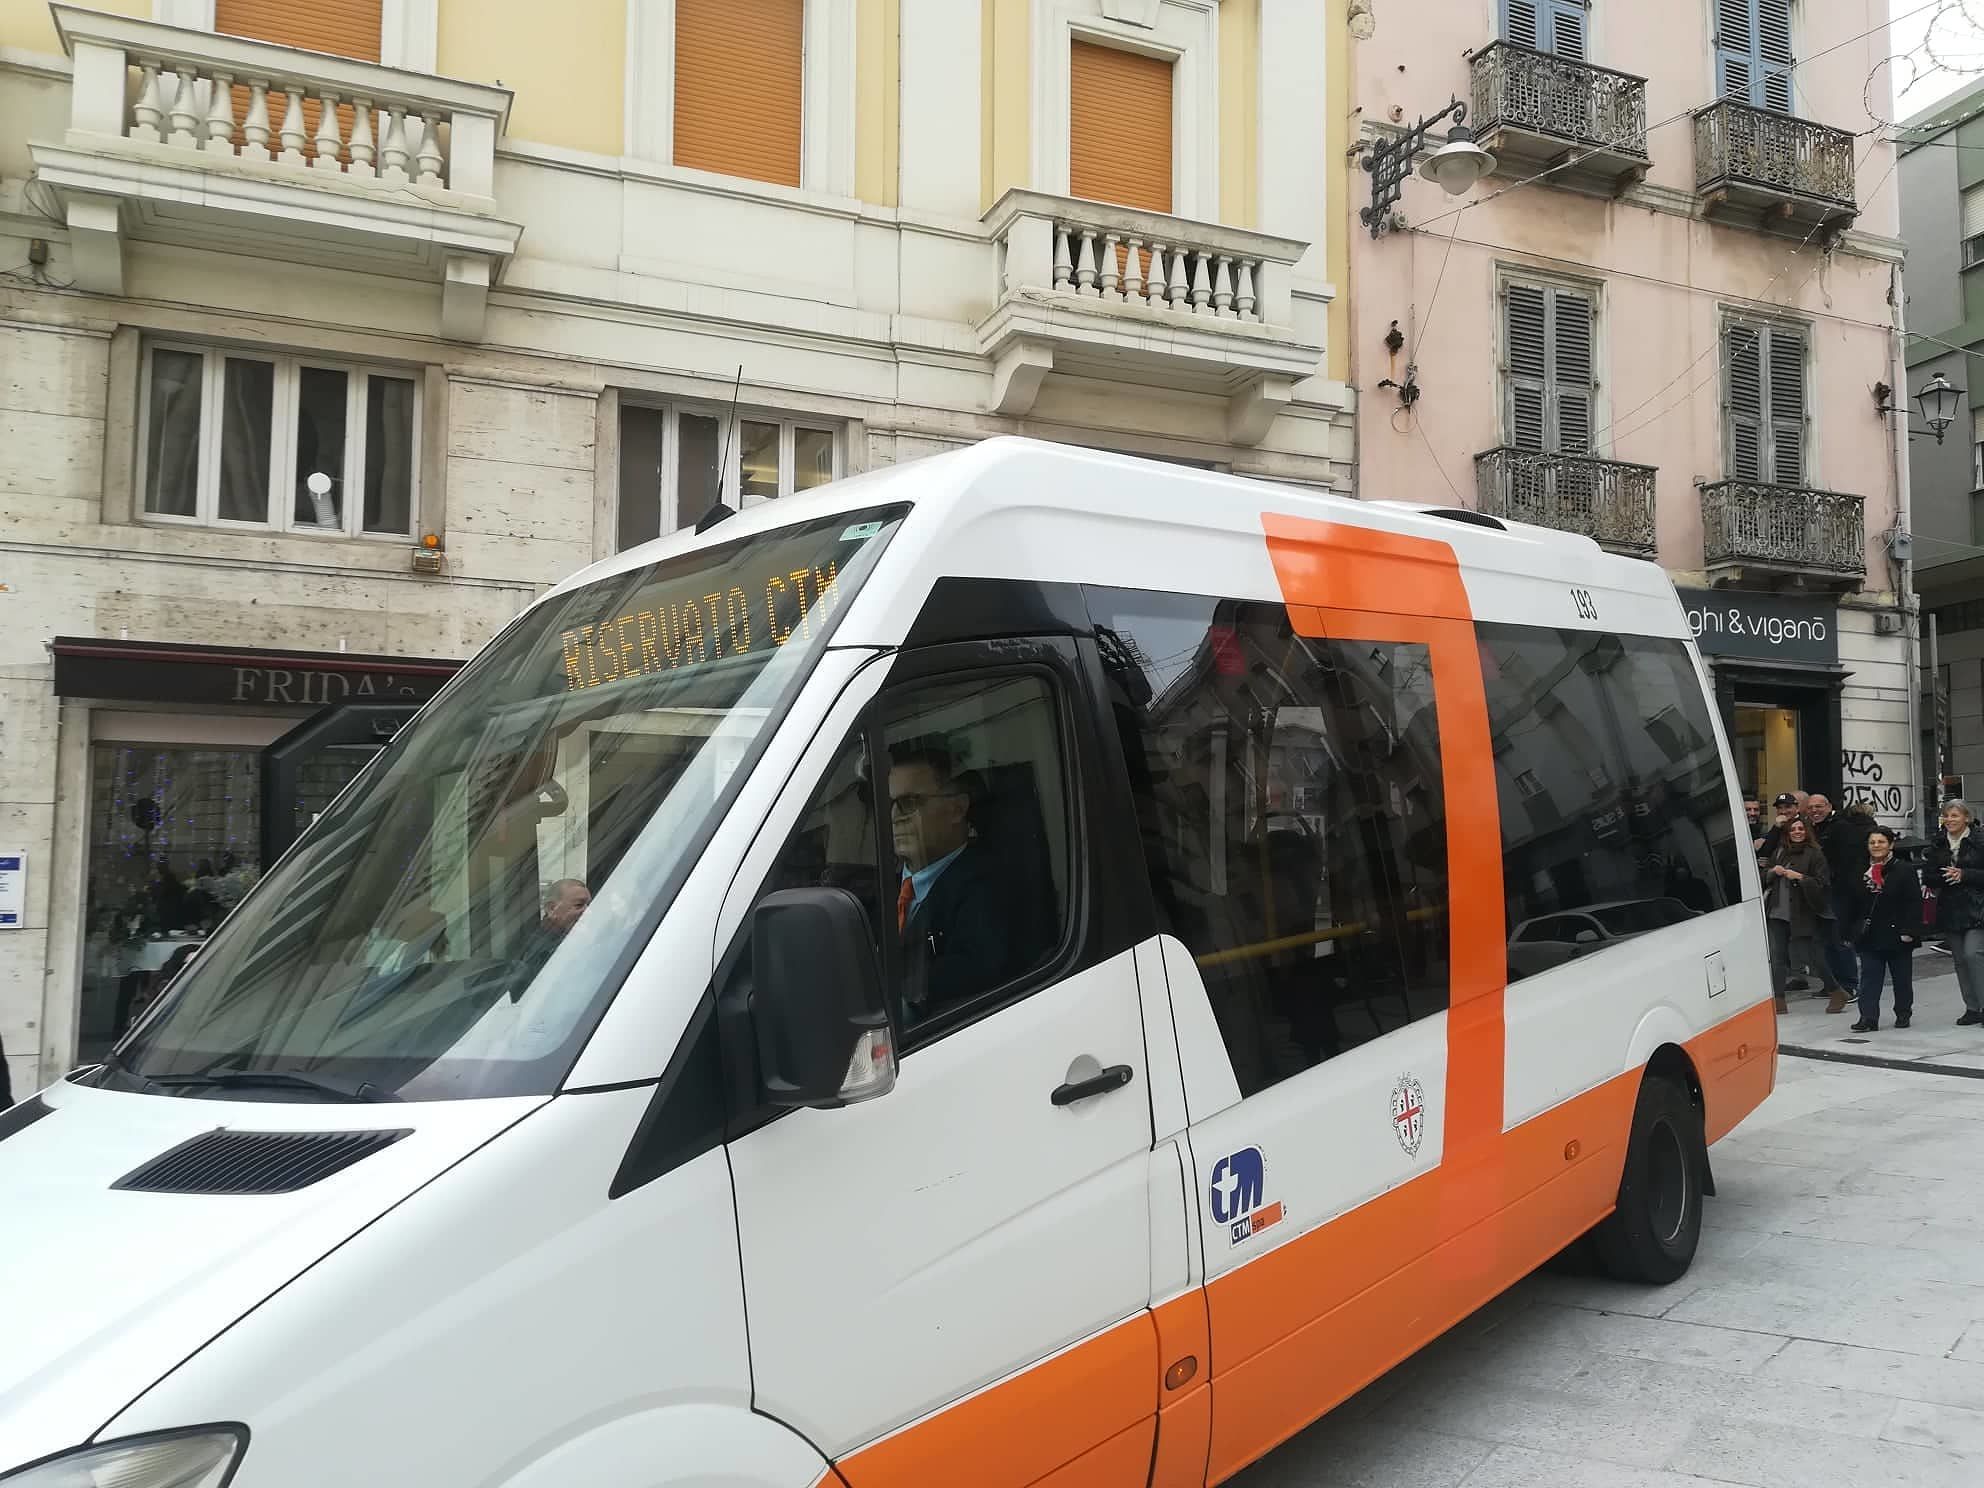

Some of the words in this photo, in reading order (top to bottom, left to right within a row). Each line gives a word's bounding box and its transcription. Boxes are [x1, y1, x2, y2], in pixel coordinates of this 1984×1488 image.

[1570, 589, 1598, 620] 193
[560, 585, 751, 691] RISERVATO
[766, 561, 839, 647] CTM
[1728, 609, 1746, 634] &
[1231, 1218, 1250, 1241] CTM
